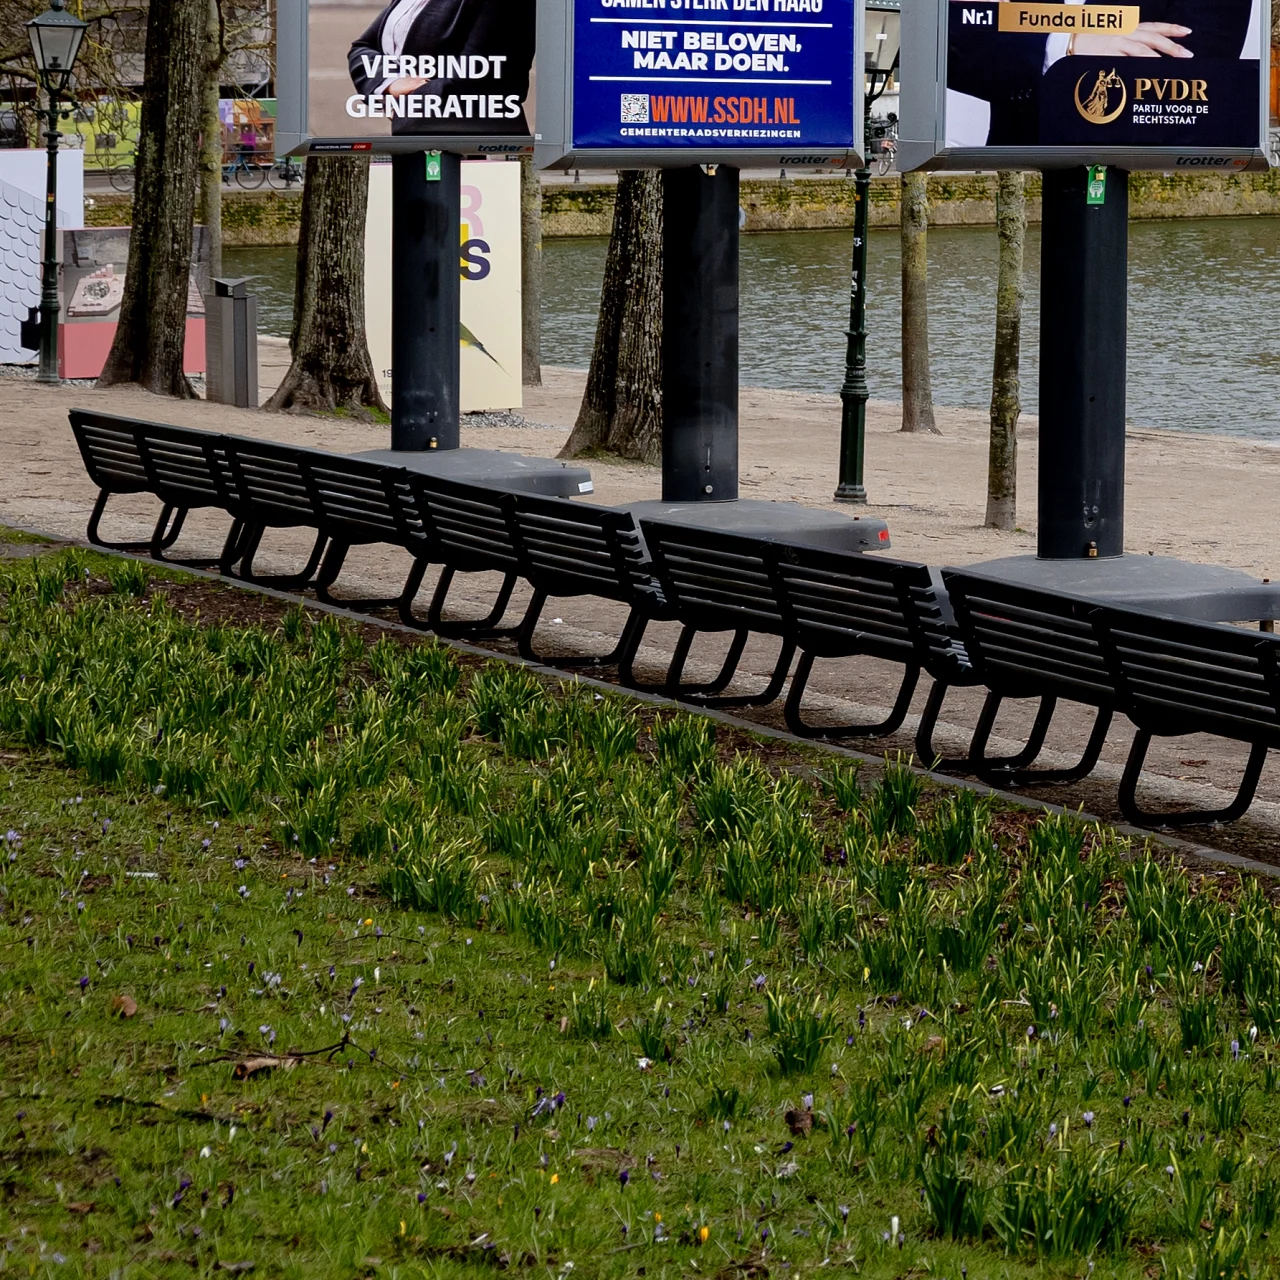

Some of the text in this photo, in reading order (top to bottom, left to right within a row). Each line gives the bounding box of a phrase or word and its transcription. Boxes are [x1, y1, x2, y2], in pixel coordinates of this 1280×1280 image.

[962, 9, 993, 25] Nr.1
[1019, 9, 1123, 28] Funda İLERİ
[621, 30, 802, 52] NIET BELOVEN,
[361, 55, 507, 79] VERBINDT
[634, 51, 789, 72] MAAR DOEN.
[1134, 78, 1208, 101] PVDR
[345, 94, 521, 118] GENERATIES
[650, 95, 800, 124] WWW.SSDH.NL
[1133, 104, 1208, 114] PARTIJ VOOR DE
[1133, 115, 1197, 124] RECHTSSTAAT
[620, 128, 801, 138] GEMEENTERAADSVERKIEZINGEN
[779, 156, 829, 164] trotter
[1176, 156, 1232, 166] trotter
